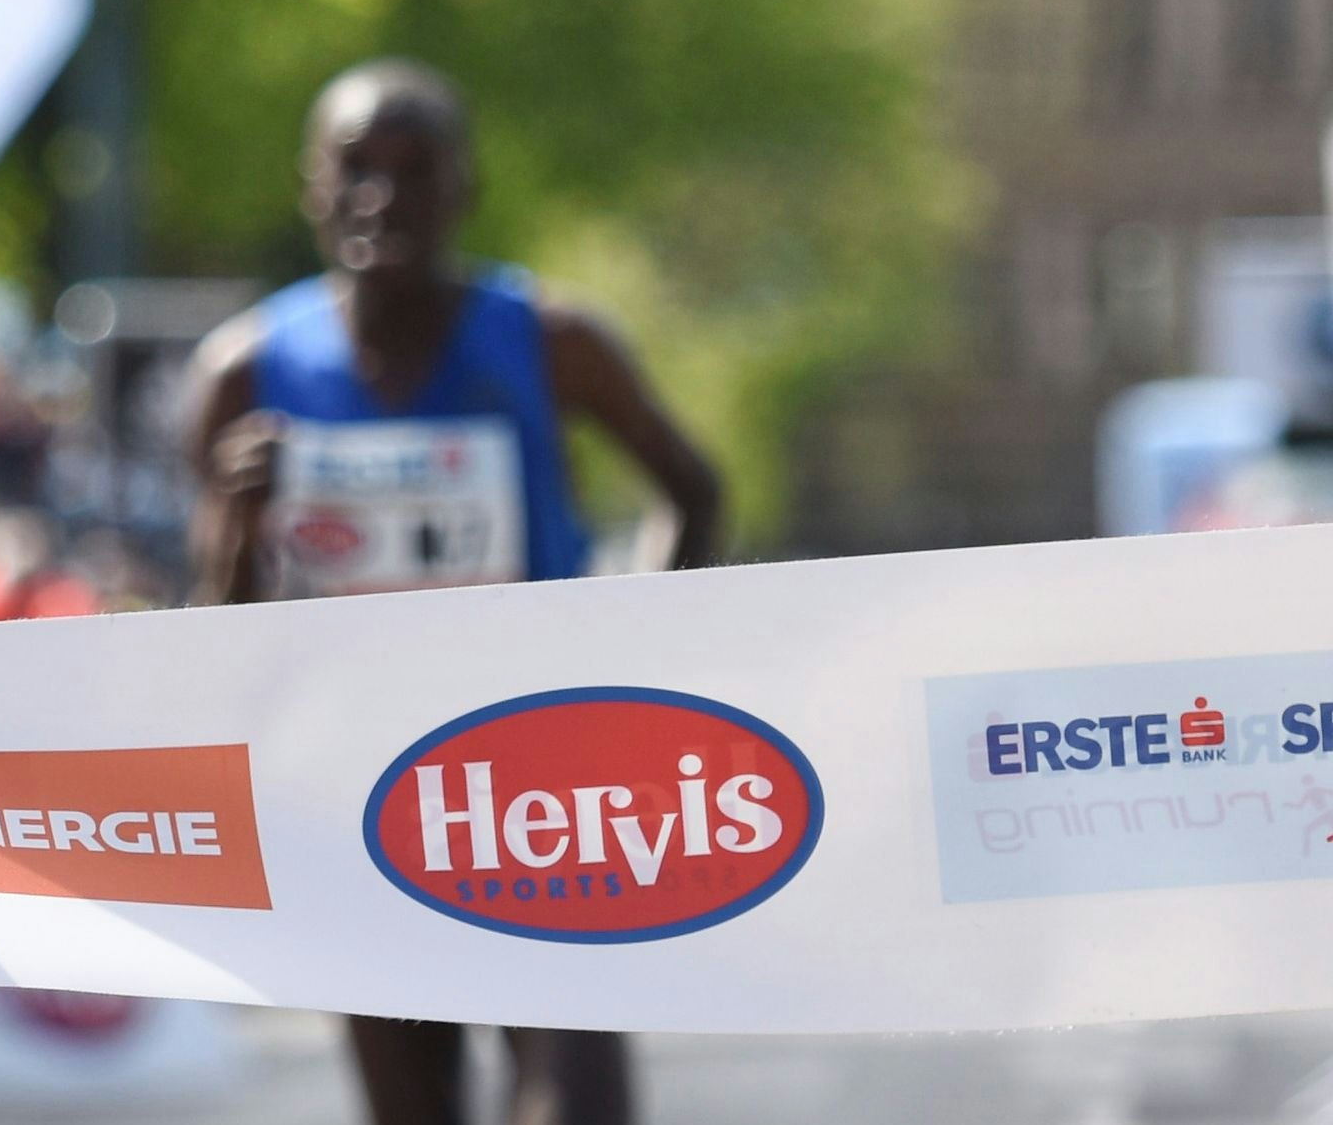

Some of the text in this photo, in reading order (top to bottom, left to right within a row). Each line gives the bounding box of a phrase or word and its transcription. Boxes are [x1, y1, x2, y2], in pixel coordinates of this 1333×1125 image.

[986, 713, 1171, 776] ERSTE
[1181, 747, 1227, 764] BANK
[414, 753, 783, 887] Hervis
[456, 871, 624, 902] SPORTS
